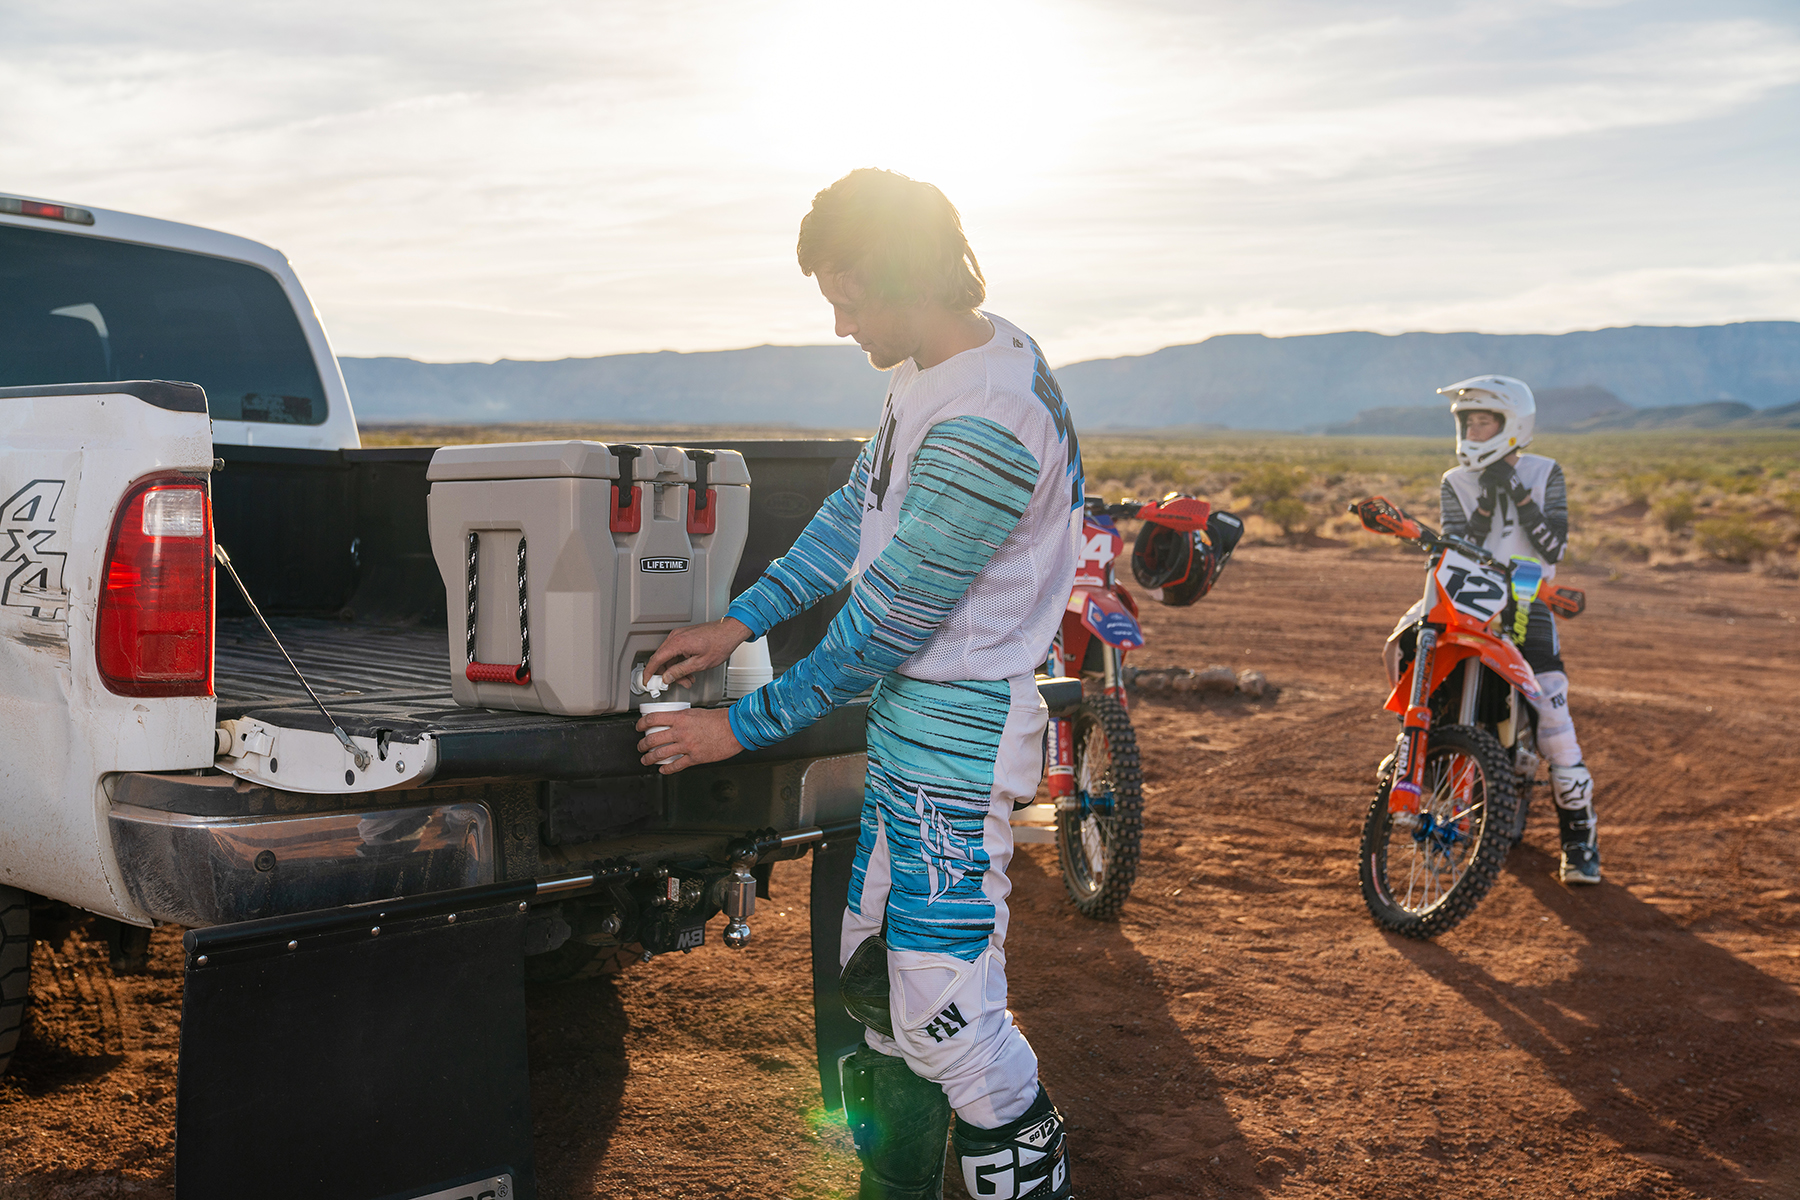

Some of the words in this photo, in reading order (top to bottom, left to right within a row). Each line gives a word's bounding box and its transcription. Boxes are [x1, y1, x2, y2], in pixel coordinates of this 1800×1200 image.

[647, 560, 684, 569] LIFETIME
[1446, 564, 1504, 617] 12
[1048, 720, 1058, 767] KENDA
[1397, 735, 1411, 776] KENDA
[925, 1001, 968, 1043] FLY
